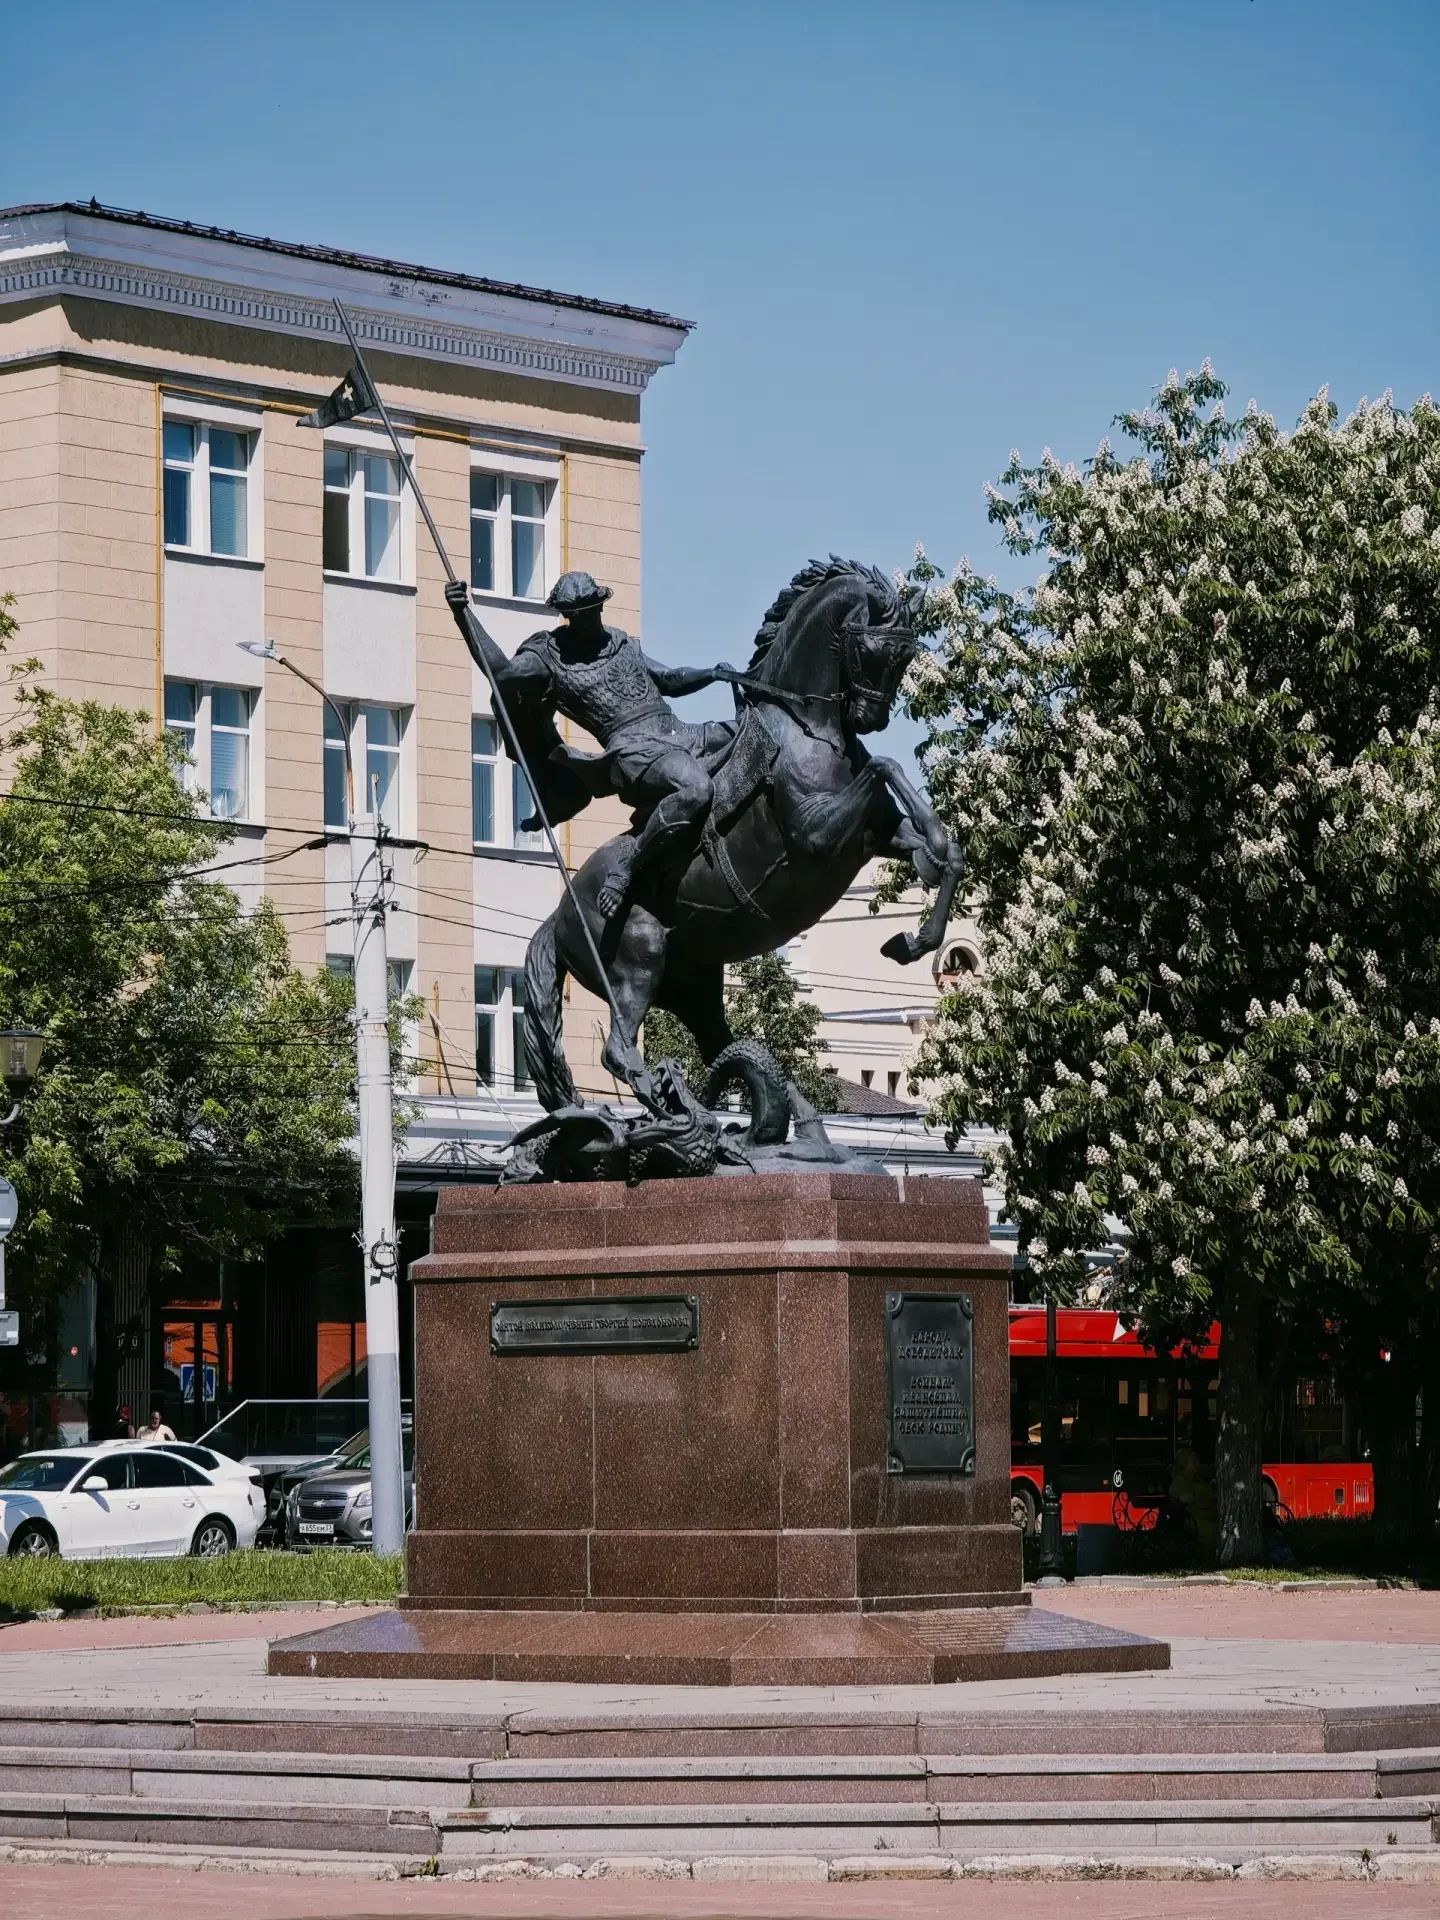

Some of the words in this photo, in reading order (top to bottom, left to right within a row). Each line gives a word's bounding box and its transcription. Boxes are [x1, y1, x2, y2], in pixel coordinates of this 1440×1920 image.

[494, 1320, 523, 1333] СВЯТОЙ
[594, 1317, 629, 1329] ГЕОРГИЙ
[898, 1346, 964, 1360] ПОБЕДИТЕЛЮ
[894, 1406, 969, 1421] ЗАЩИТИВШИМ
[899, 1421, 925, 1435] СВОЮ
[928, 1421, 966, 1436] РОДИНУ
